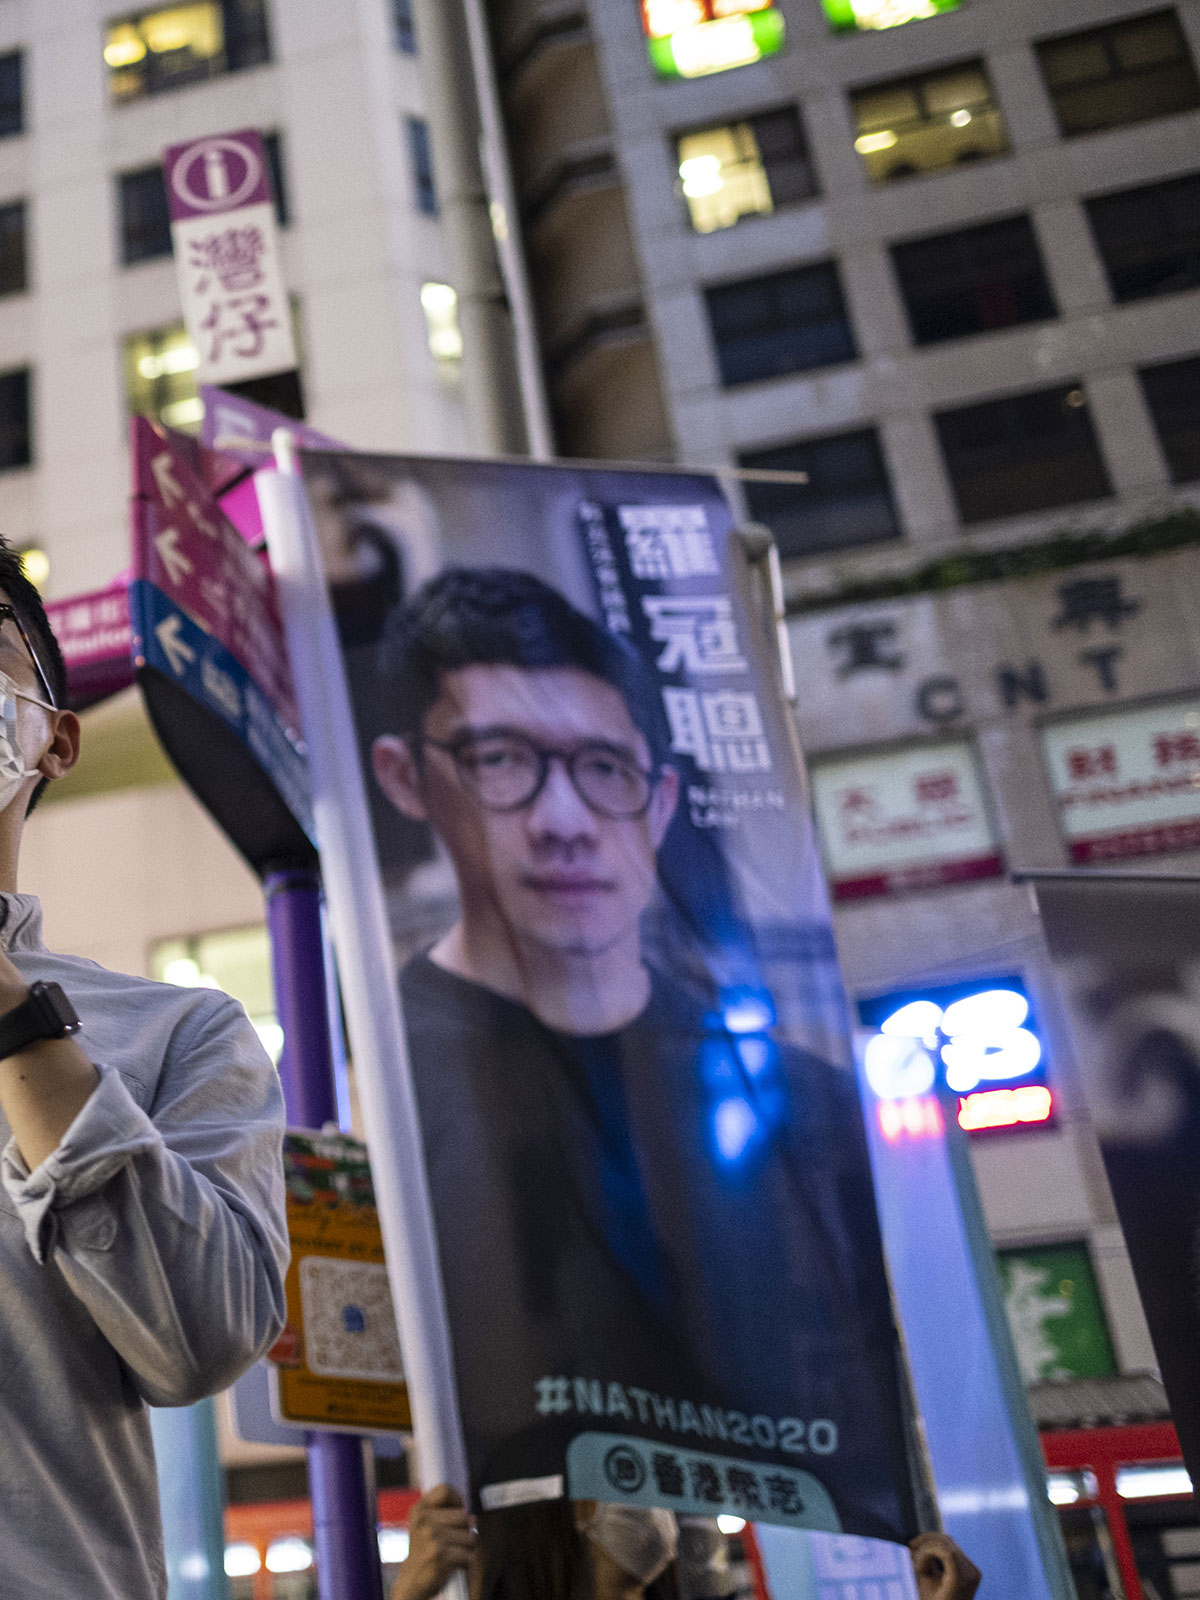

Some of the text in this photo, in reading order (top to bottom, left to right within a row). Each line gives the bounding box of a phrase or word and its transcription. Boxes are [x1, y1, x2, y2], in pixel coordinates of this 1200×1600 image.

[188, 227, 278, 363] 灣仔
[617, 504, 772, 772] 羅冠聰
[535, 1375, 838, 1455] #NATHAN2020
